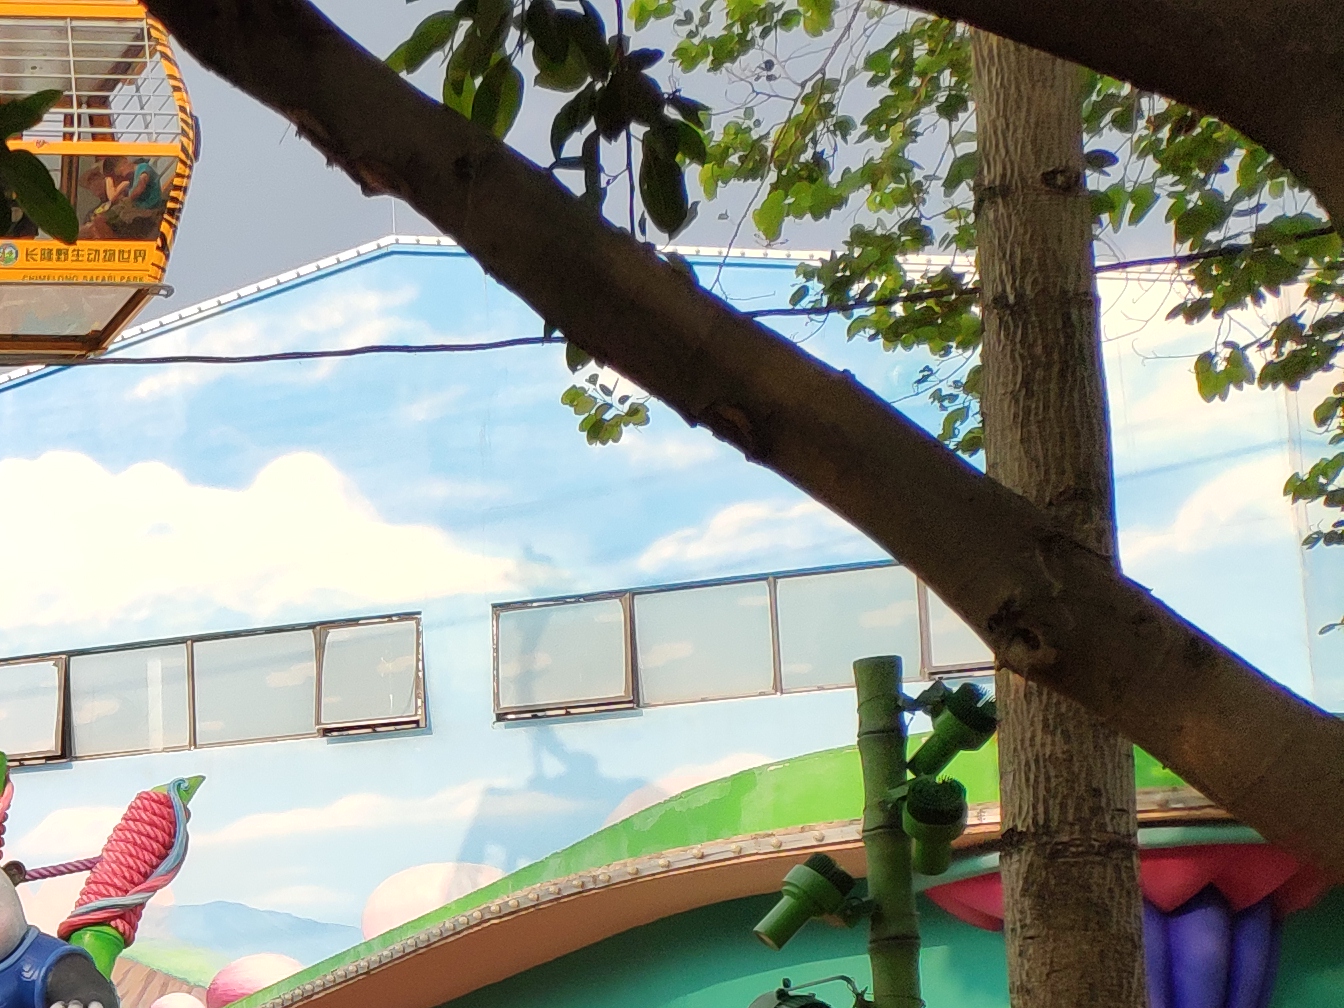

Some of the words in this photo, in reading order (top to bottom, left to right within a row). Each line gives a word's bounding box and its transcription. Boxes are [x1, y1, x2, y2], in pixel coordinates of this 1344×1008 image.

[25, 247, 147, 263] 长隆野生动物世界
